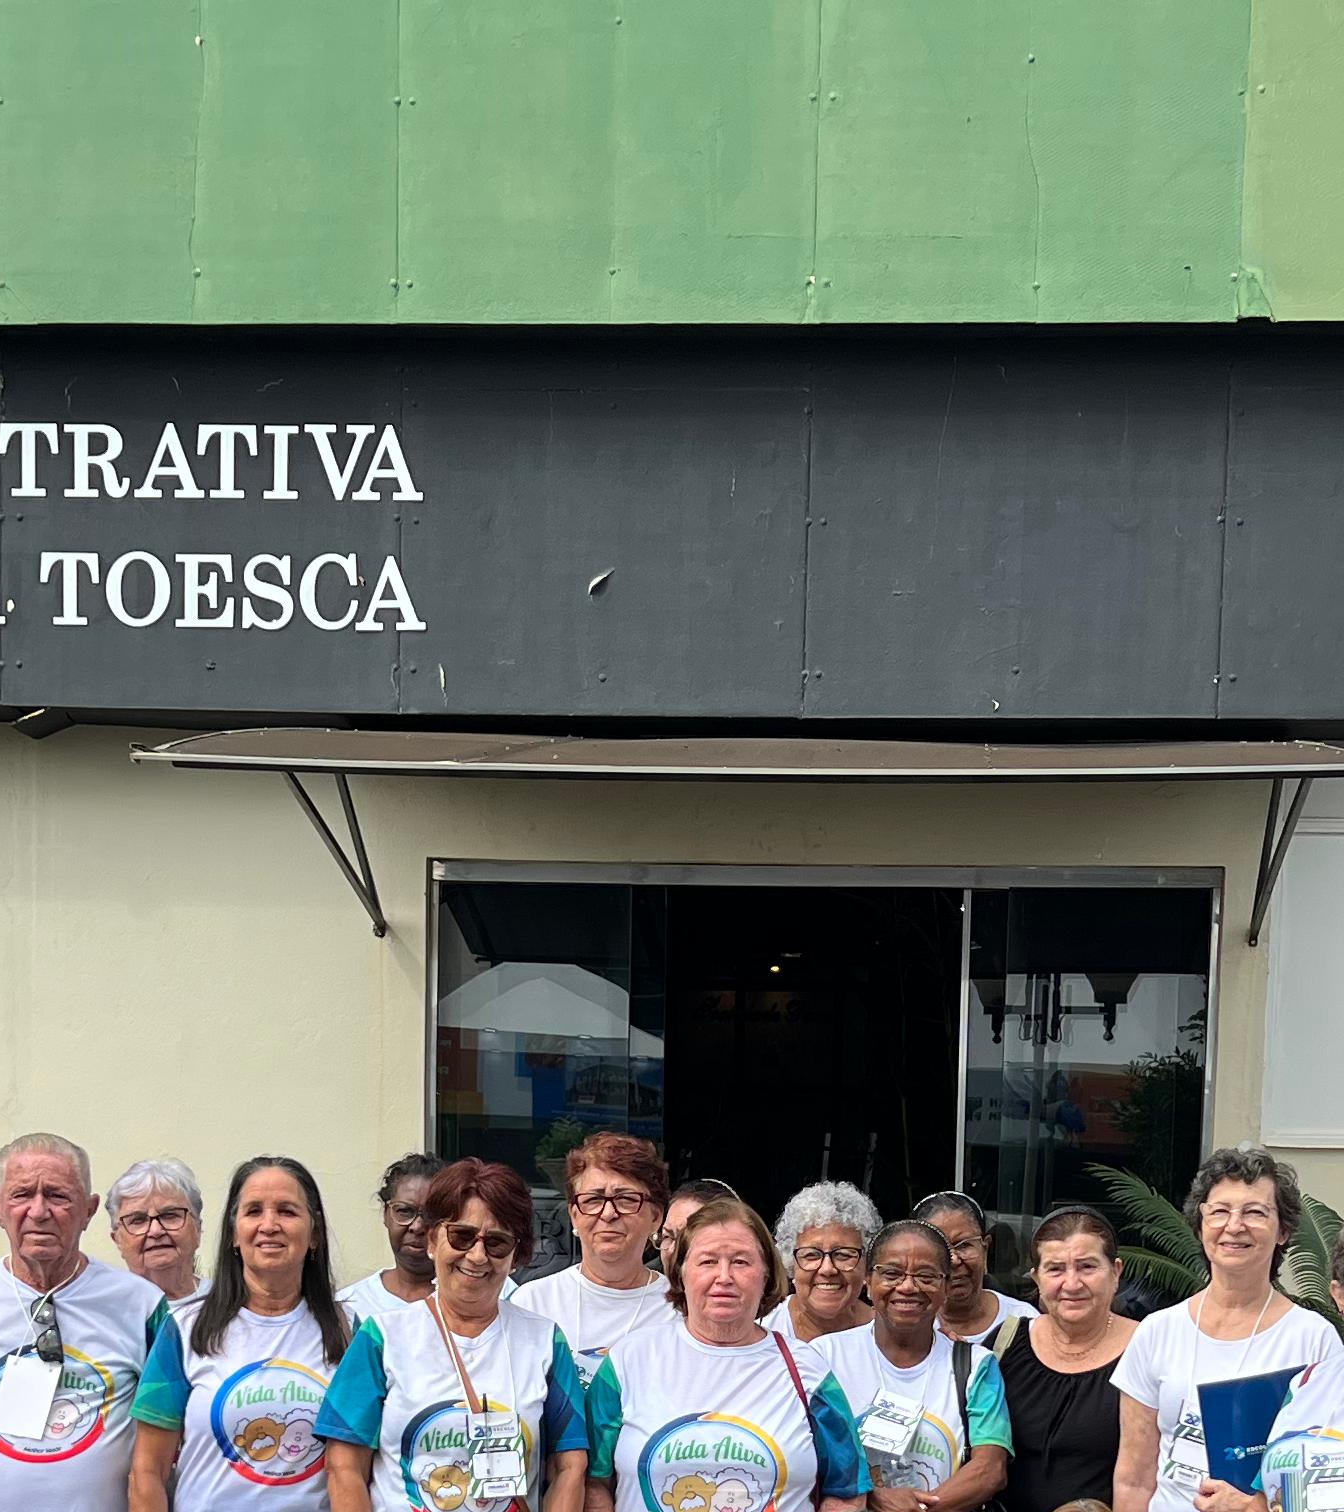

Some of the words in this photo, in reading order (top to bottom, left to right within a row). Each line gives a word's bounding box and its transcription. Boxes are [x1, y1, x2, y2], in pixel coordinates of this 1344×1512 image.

[39, 550, 427, 632] TOESCA
[58, 1371, 97, 1392] tiva
[230, 1385, 276, 1408] Vida
[420, 1427, 465, 1452] Vida
[658, 1438, 709, 1463] Vida
[712, 1435, 768, 1468] Ativa
[1223, 1446, 1246, 1460] 20
